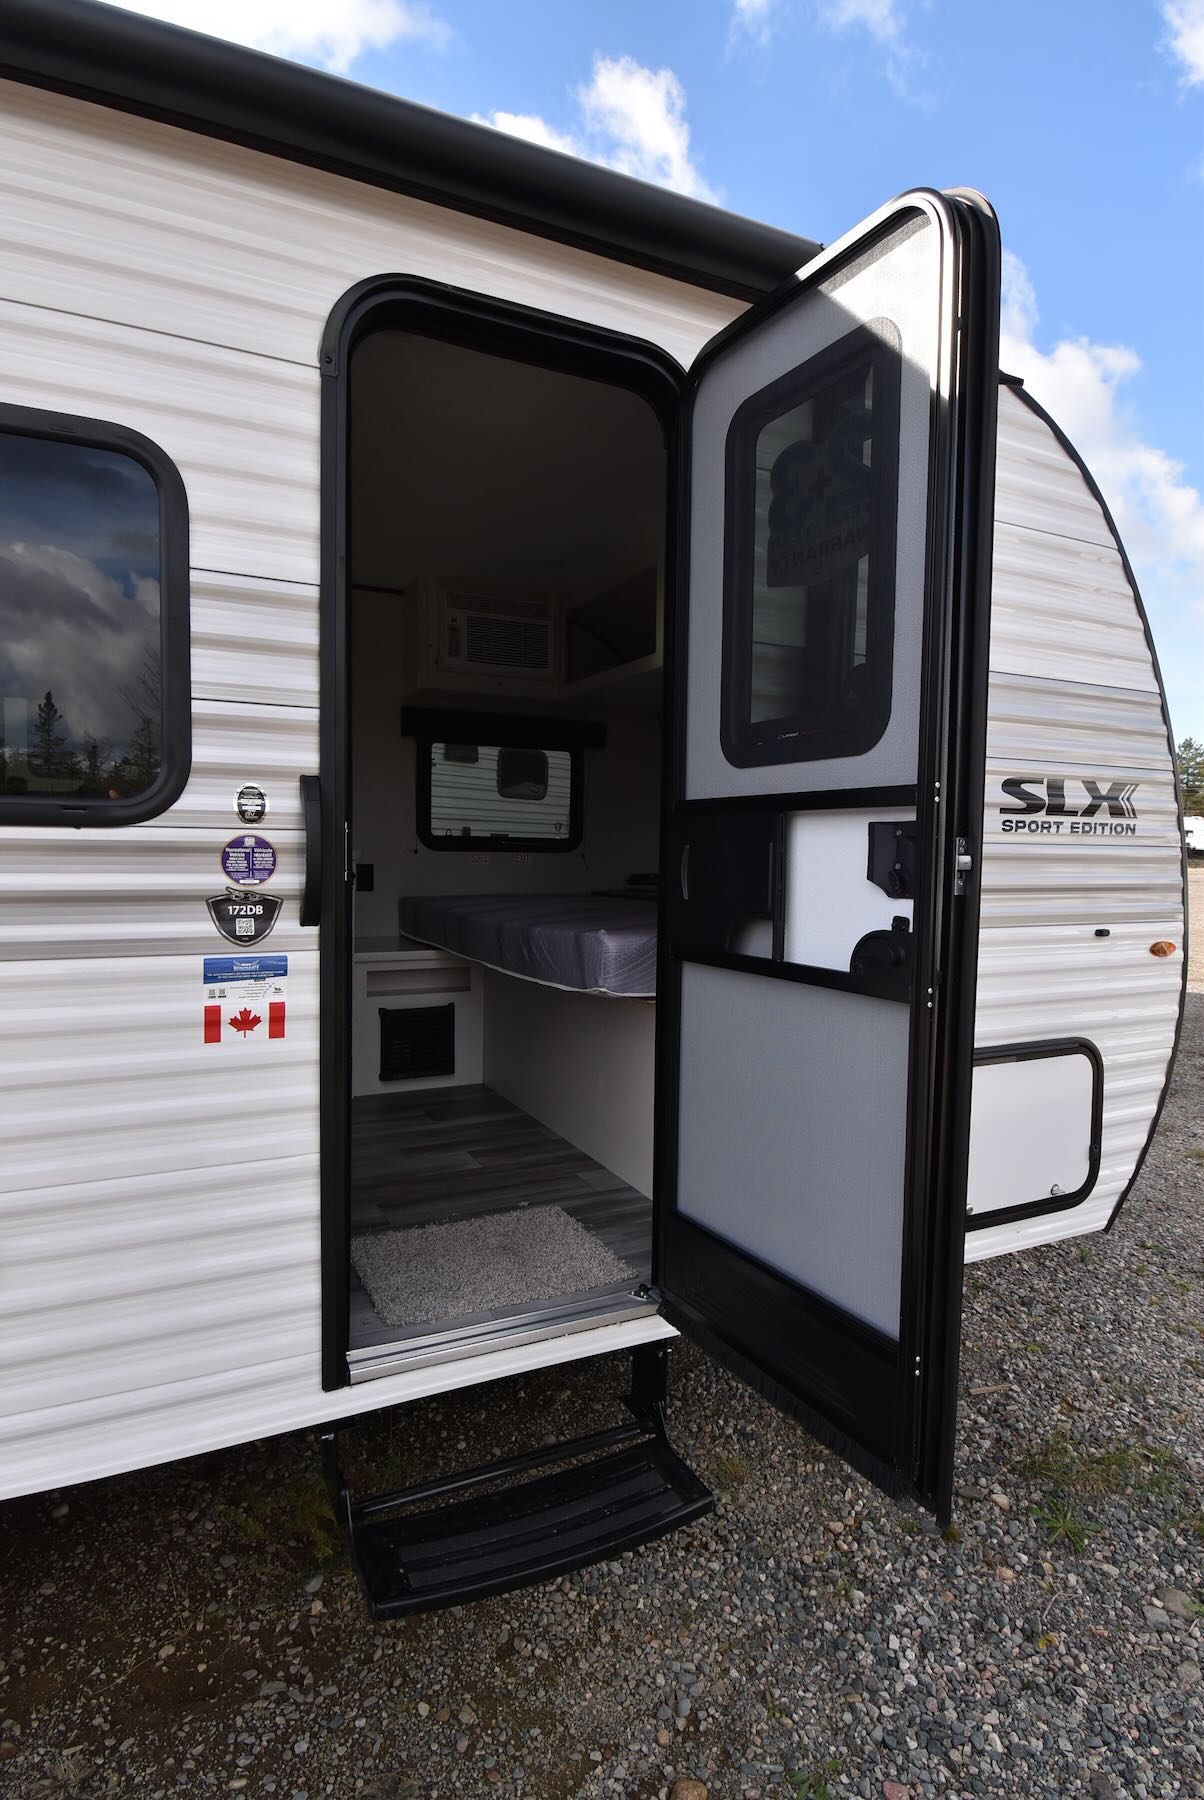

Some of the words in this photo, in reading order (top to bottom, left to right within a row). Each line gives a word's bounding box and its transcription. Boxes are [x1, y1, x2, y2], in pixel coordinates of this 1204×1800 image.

[1000, 777, 1140, 819] SLX
[1001, 819, 1064, 834] SPORT
[1070, 821, 1137, 836] EDITION
[227, 905, 264, 915] 172DB
